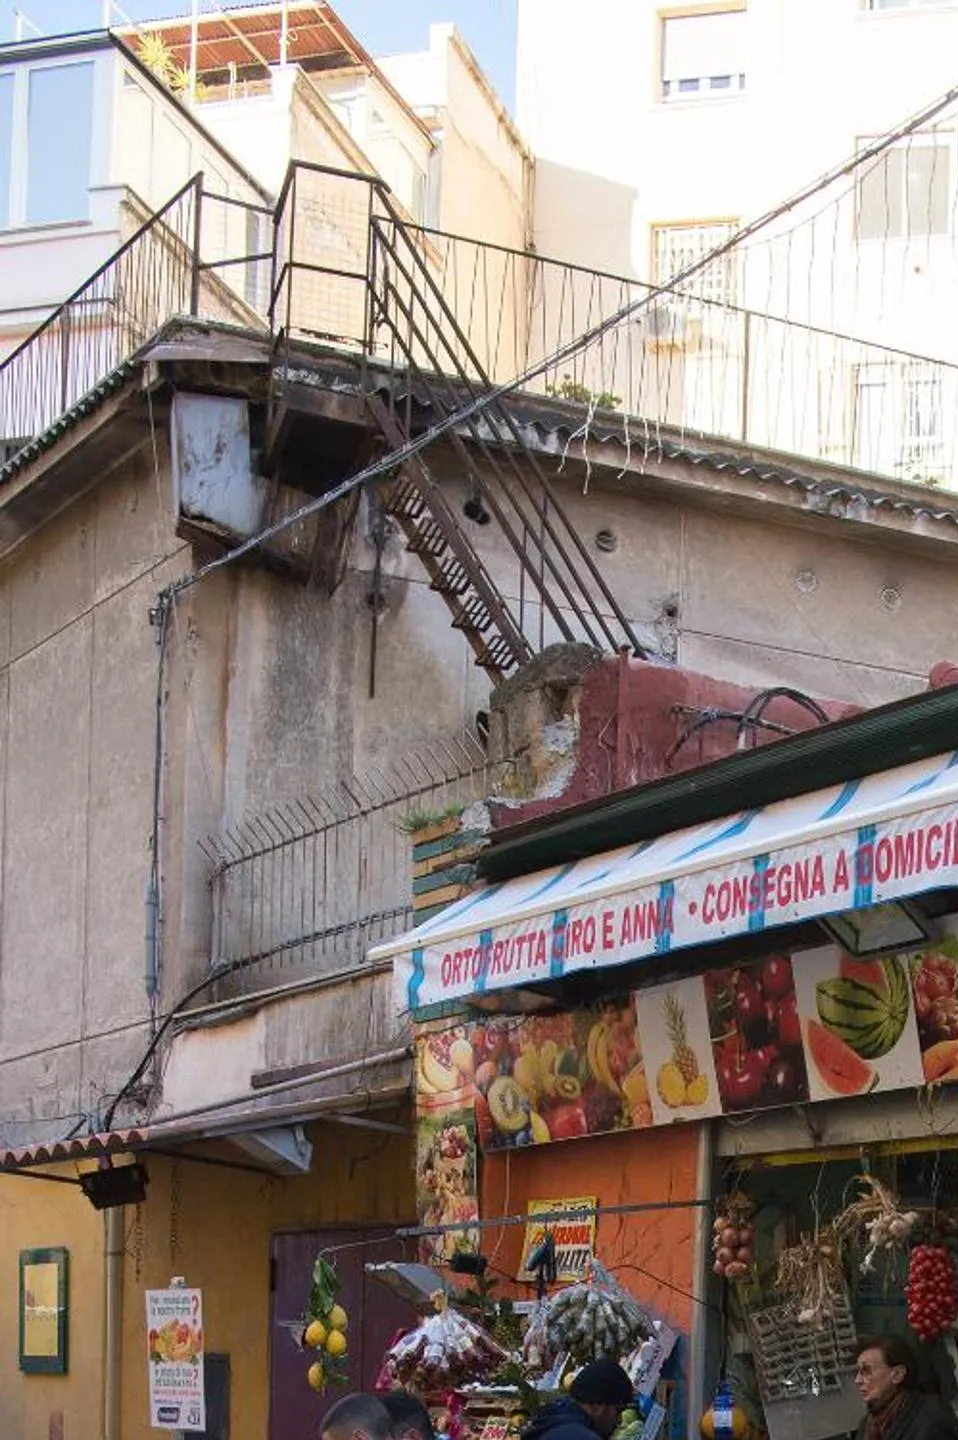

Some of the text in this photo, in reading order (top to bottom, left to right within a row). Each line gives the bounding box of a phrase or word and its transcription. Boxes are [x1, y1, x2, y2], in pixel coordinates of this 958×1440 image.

[441, 928, 547, 987] ORTOFRUTTA
[602, 911, 615, 949] E
[621, 897, 675, 946] ANNA
[702, 855, 825, 925] CONSEGNA
[832, 849, 850, 893] A
